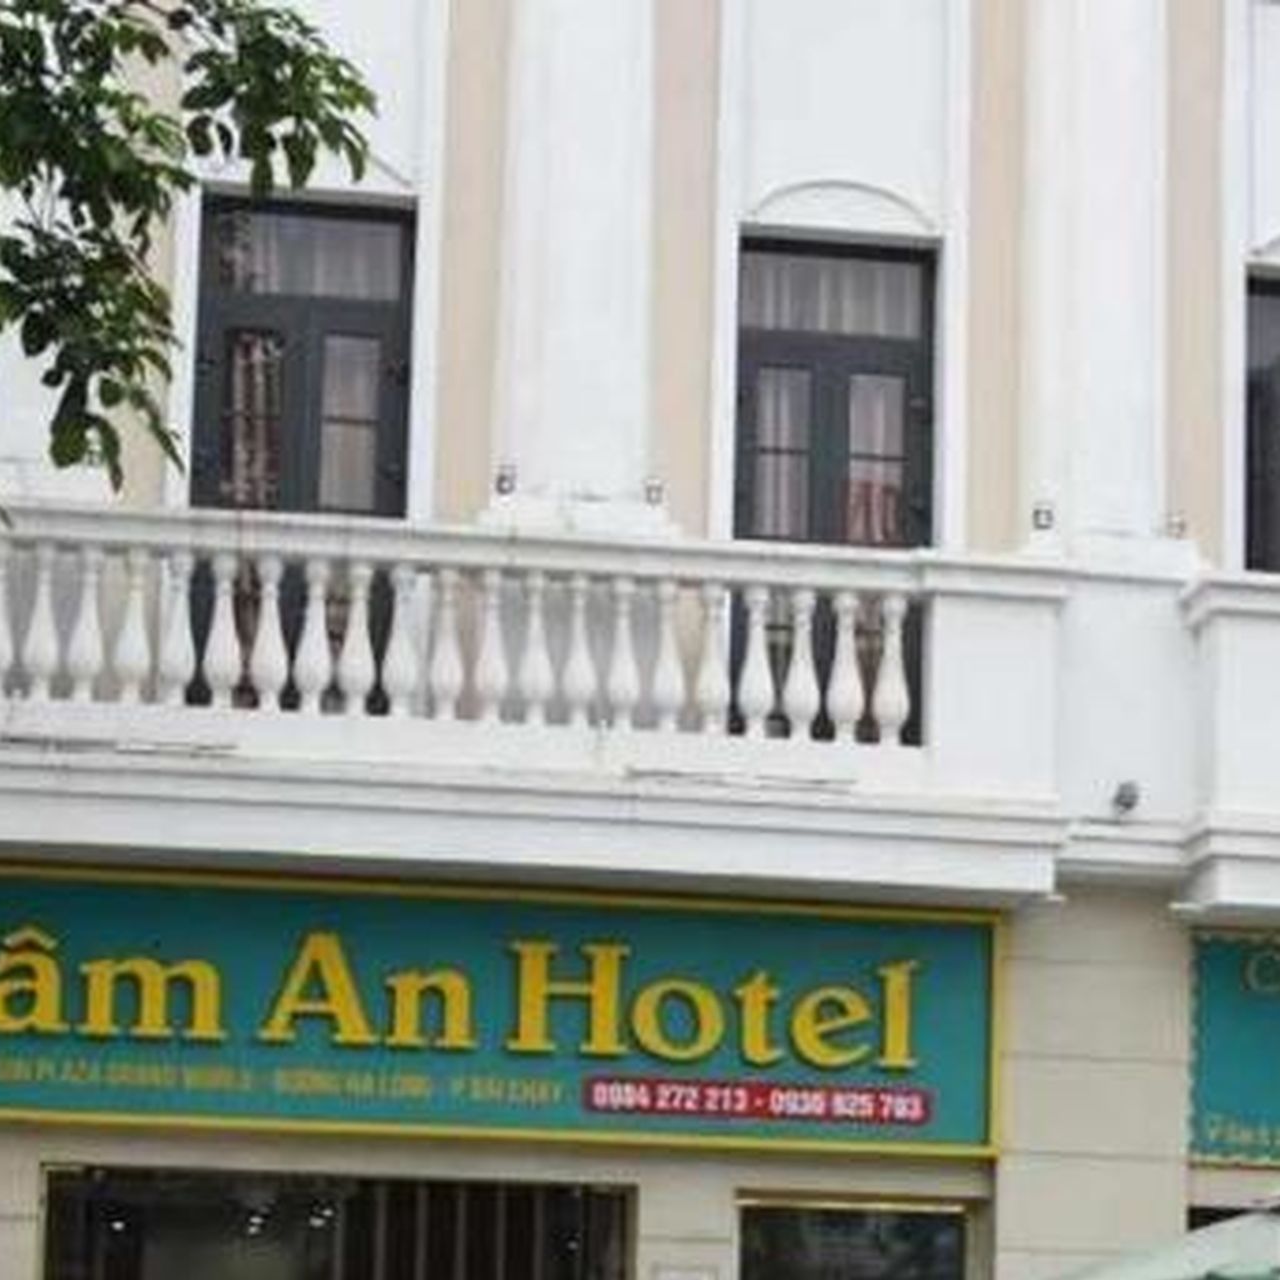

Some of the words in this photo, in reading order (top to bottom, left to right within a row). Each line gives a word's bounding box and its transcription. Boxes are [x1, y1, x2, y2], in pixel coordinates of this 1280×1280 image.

[261, 930, 480, 1049] An
[506, 937, 919, 1071] Hotel
[655, 1083, 700, 1111] 272
[704, 1084, 748, 1112] 213
